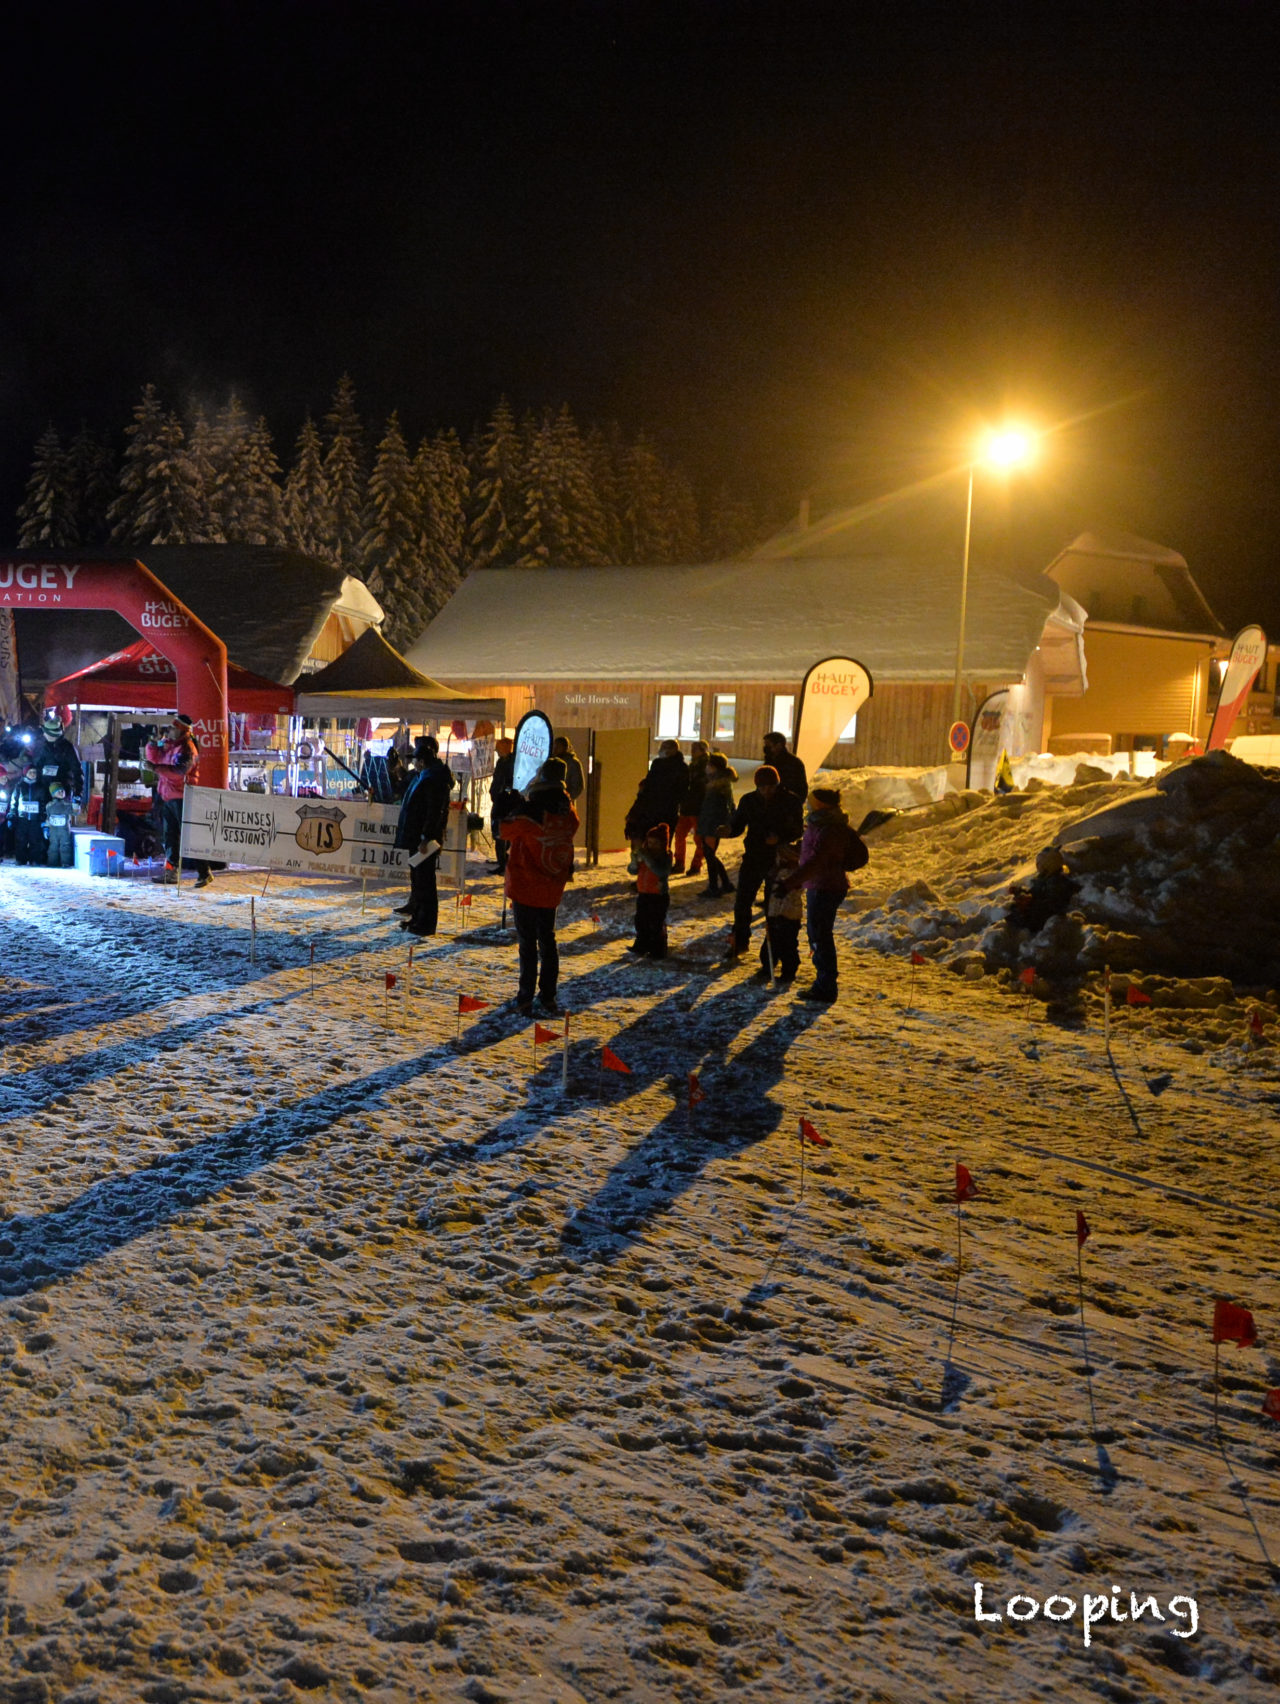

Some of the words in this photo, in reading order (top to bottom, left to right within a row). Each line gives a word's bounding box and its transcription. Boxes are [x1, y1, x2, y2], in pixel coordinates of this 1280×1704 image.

[141, 612, 190, 628] BUGEY
[1237, 644, 1260, 654] HAUT
[1233, 651, 1258, 664] BUGEY
[817, 673, 857, 684] HAUT
[811, 681, 860, 696] BUGEY
[564, 694, 587, 704] Salle
[588, 694, 630, 705] Hors-Sac
[524, 729, 546, 747] HAUT
[520, 742, 545, 759] BUGEY
[205, 811, 218, 821] LES
[223, 808, 271, 827] INTENSES
[359, 821, 377, 833] TRAIL
[379, 824, 398, 835] NOCT
[223, 829, 266, 846] SESSIONS
[360, 848, 376, 864] 11
[382, 850, 402, 866] DEC
